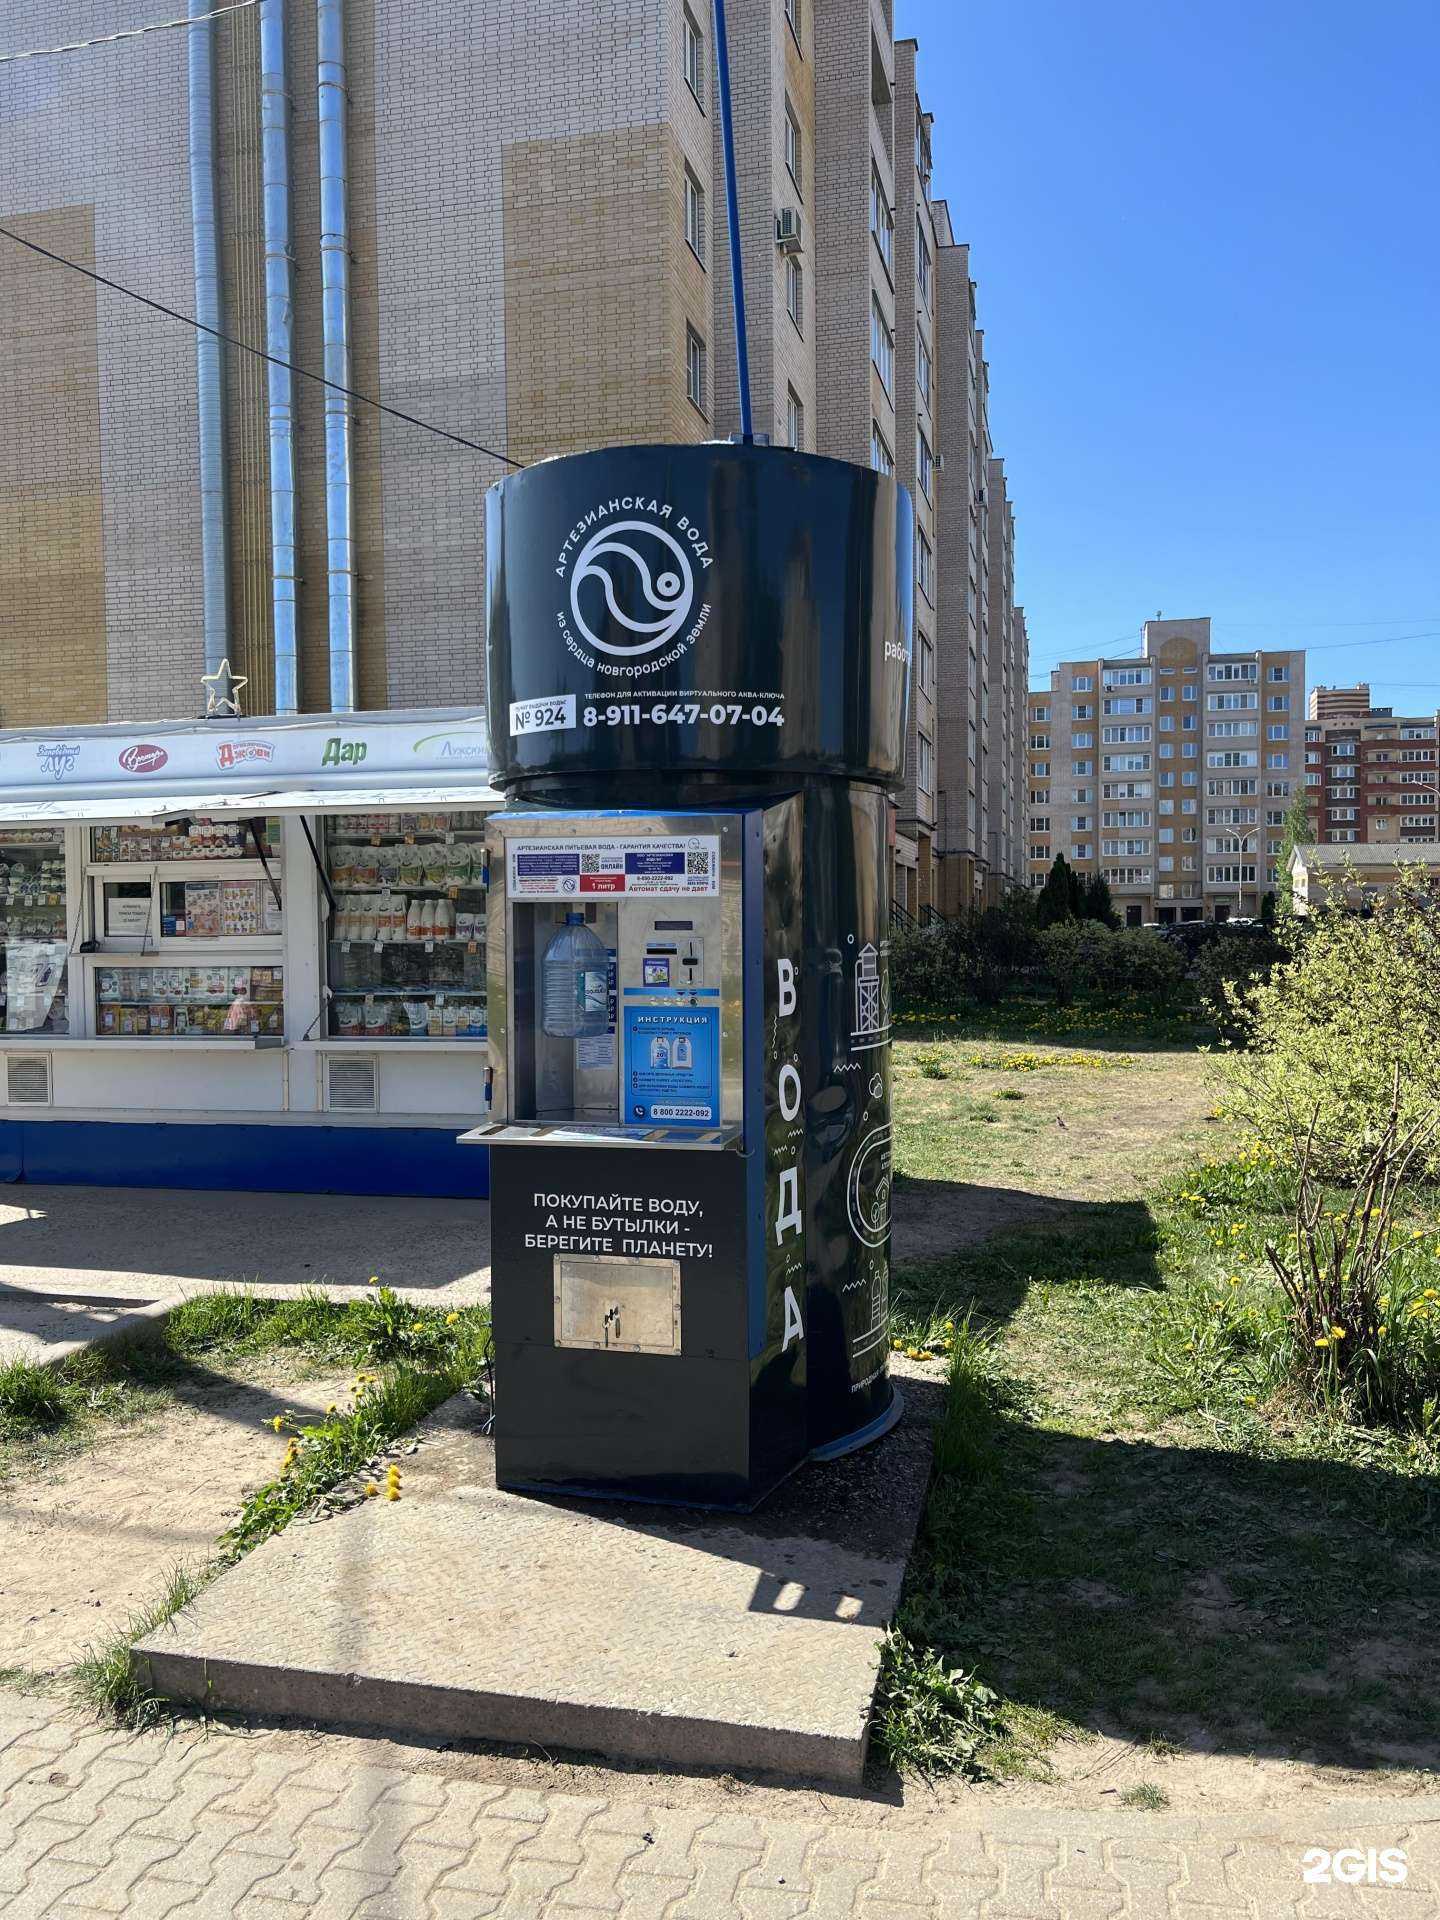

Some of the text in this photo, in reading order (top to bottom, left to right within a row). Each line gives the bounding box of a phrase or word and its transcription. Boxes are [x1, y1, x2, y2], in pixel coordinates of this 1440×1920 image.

[555, 497, 714, 578] АРТЕЗИАНСКАЯ ВОДА
[556, 602, 712, 679] из сердца новгородской земли
[584, 690, 785, 700] ТЕЛЕФОН ДЛЯ АКТИВАЦИИ ВИРТУАЛЬНОГО АКВА-КЛЮЧА
[535, 706, 566, 727] 924
[583, 703, 785, 727] 8-911-647-07-04
[321, 737, 368, 766] Дар
[598, 843, 616, 851] ВОДА
[597, 883, 616, 891] литр
[638, 1016, 708, 1024] ИНСТРУКЦИЯ
[659, 1108, 674, 1116] 800
[675, 1109, 709, 1117] 2222-092
[533, 1192, 704, 1218] ПОКУПАЙТЕ ВОДУ,
[545, 1215, 558, 1229] А
[563, 1216, 587, 1230] НЕ
[591, 1217, 679, 1235] БУТЫЛКИ
[524, 1233, 713, 1258] БЕРЕГИТЕ ПЛАНЕТУ!
